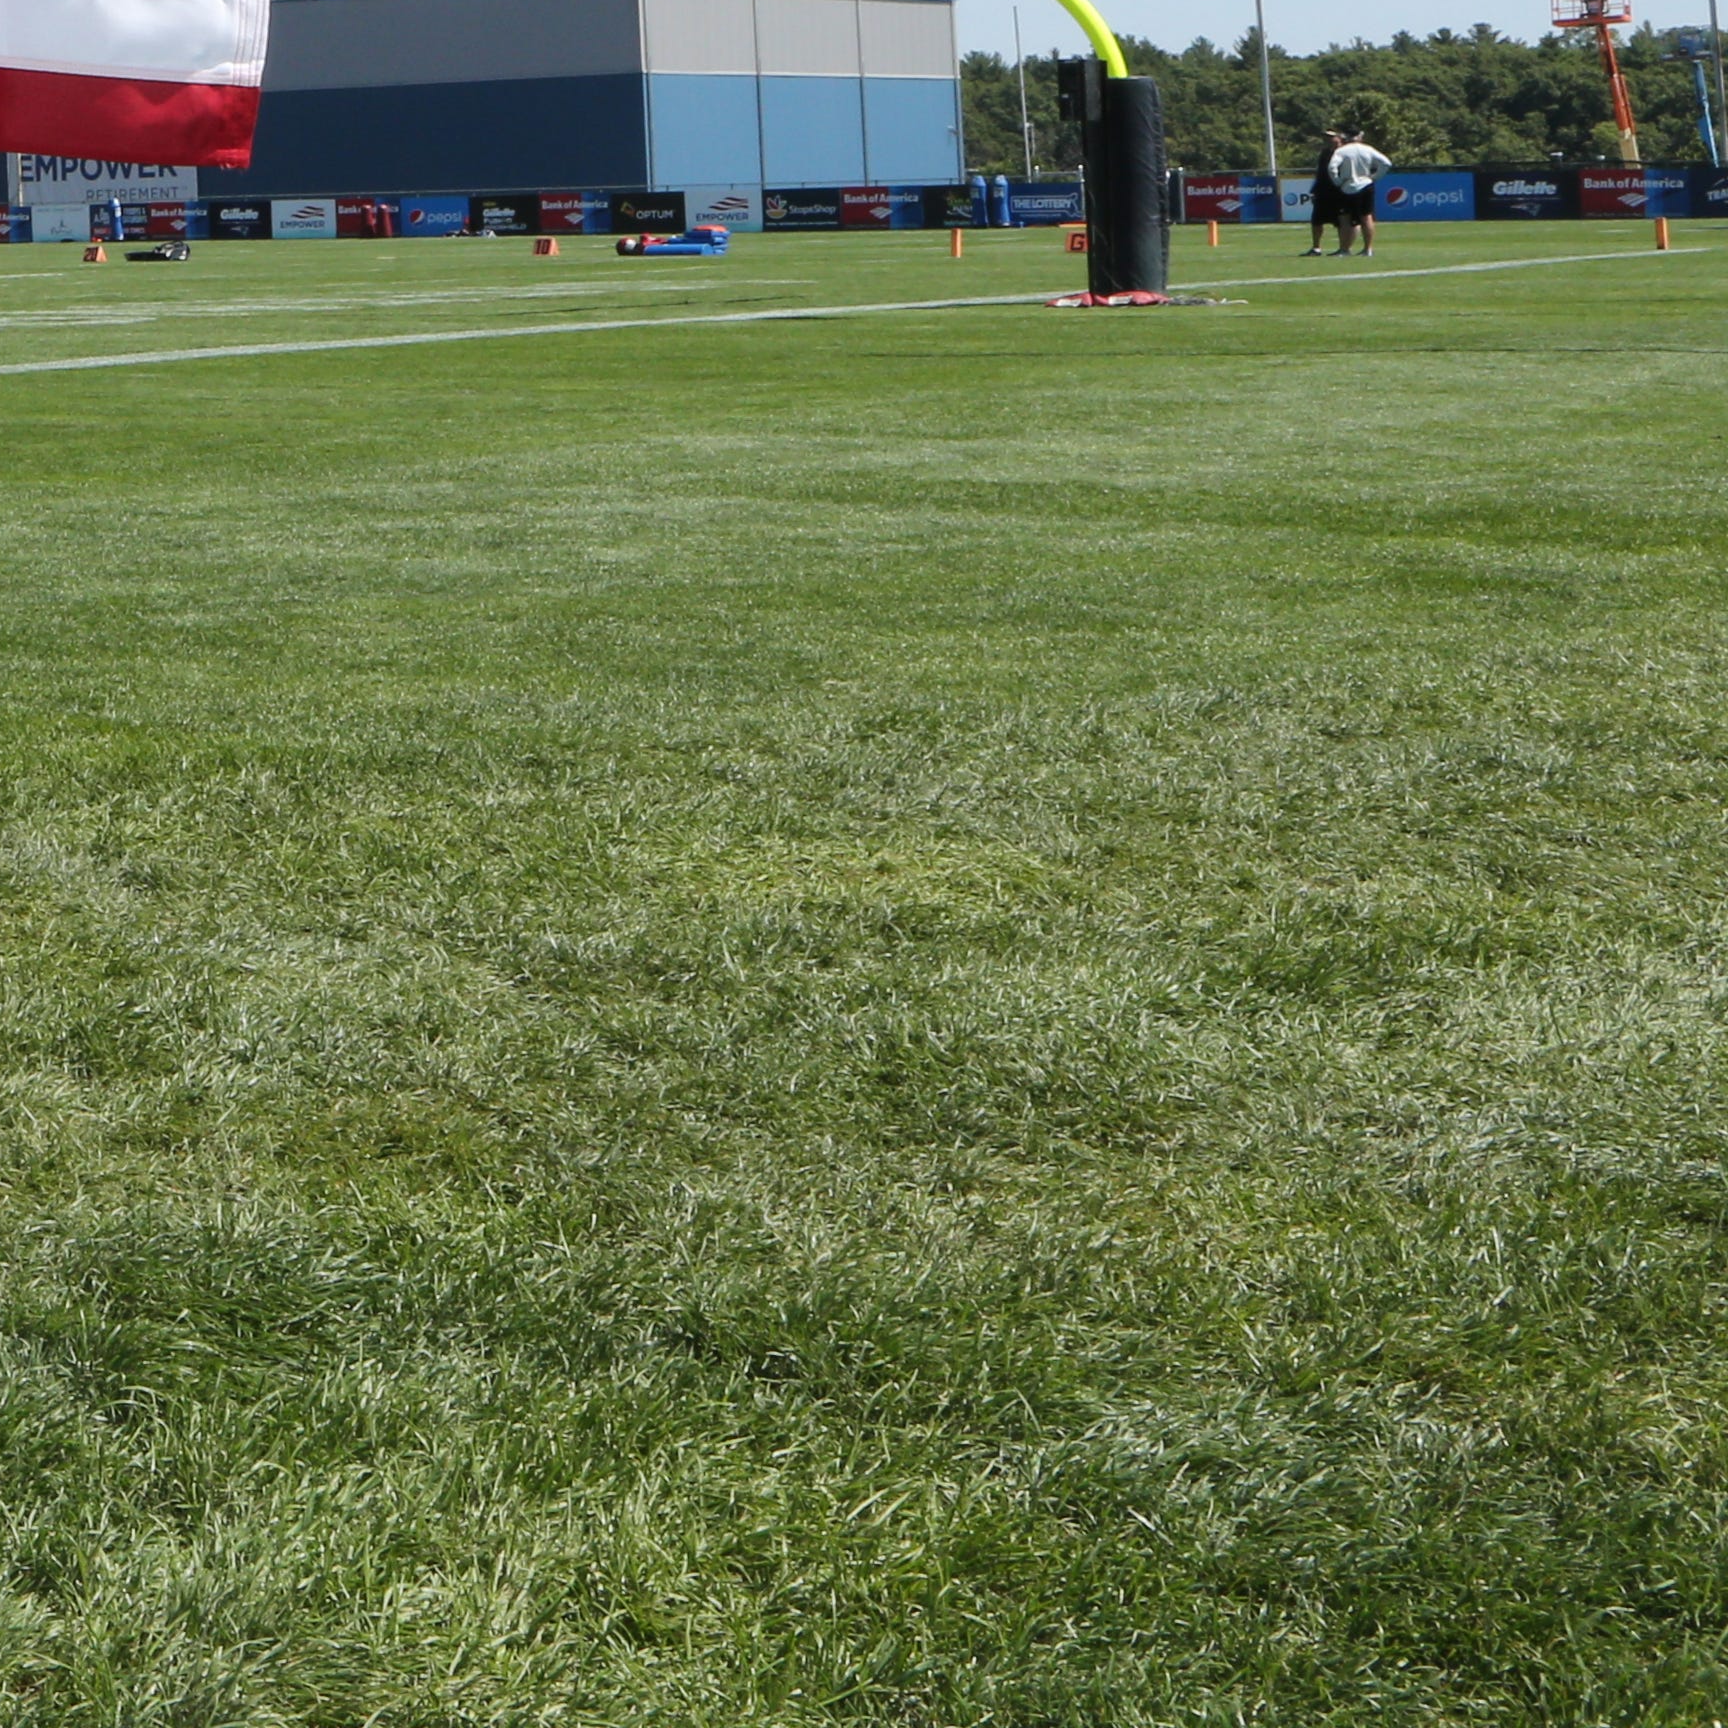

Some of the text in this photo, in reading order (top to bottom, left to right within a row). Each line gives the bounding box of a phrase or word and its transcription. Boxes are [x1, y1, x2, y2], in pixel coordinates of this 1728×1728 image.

[21, 154, 178, 182] EMPOWER
[1492, 180, 1558, 196] Gillette
[1583, 176, 1685, 189] Bank of America
[86, 186, 180, 202] RETIREMENT
[1187, 183, 1274, 196] Bank of America
[844, 192, 920, 204] Bank of America
[1013, 198, 1072, 210] THE LOTTERY
[1412, 188, 1464, 207] pepsi
[542, 200, 609, 210] Bank of America
[150, 208, 169, 218] Bank
[169, 207, 177, 217] of
[177, 207, 208, 217] America
[220, 208, 259, 221] Gillette
[427, 211, 463, 225] pepsi
[636, 210, 675, 220] OPTUM
[695, 212, 749, 222] EMPOWER
[279, 220, 326, 229] EMPOWER
[1070, 233, 1085, 250] G
